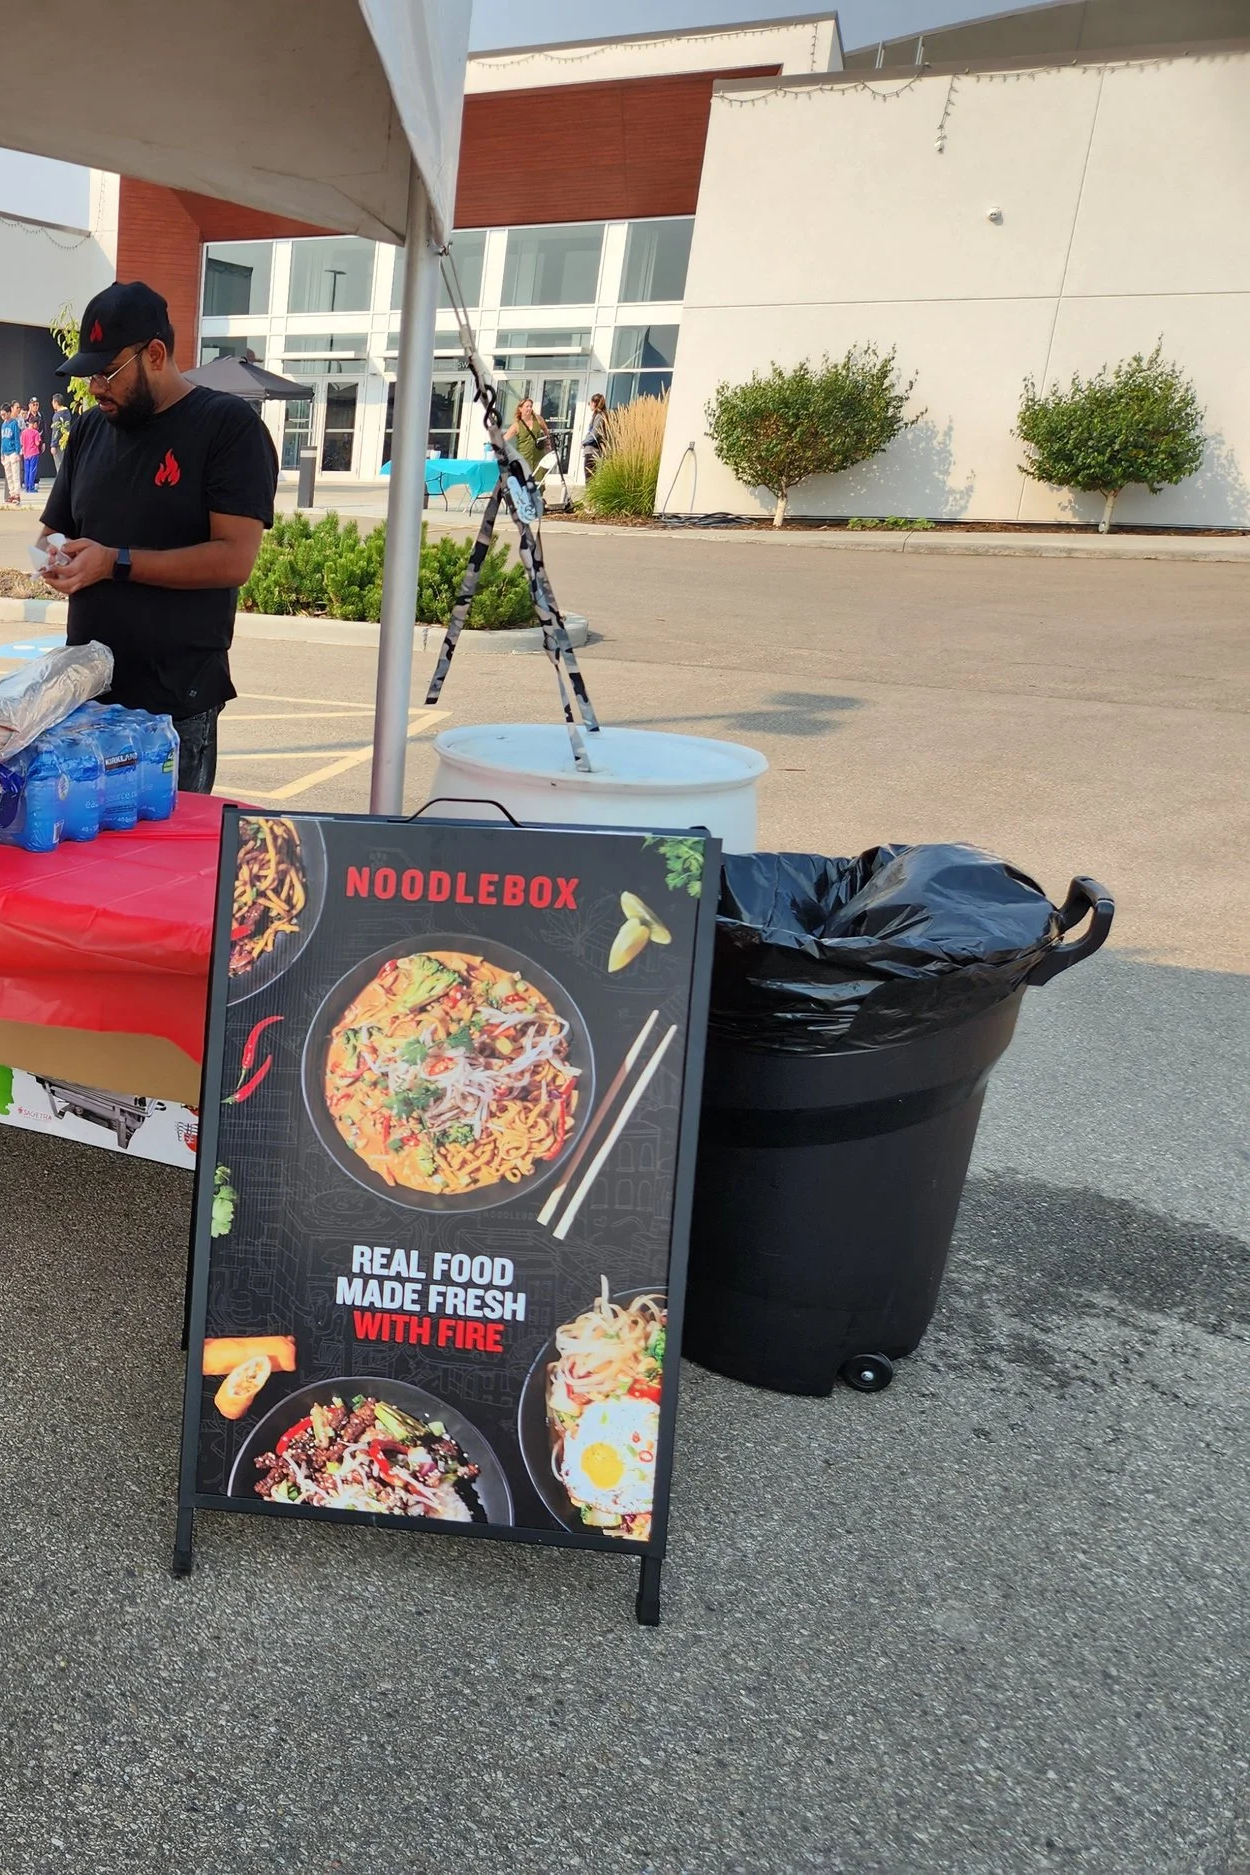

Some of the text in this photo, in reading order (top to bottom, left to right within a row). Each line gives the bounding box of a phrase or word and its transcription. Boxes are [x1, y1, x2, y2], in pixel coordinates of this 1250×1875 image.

[346, 866, 579, 910] NOODLEBOX
[351, 1245, 514, 1287] REAL FOOD
[335, 1276, 526, 1322] MADE FRESH
[353, 1310, 505, 1353] WITH FIRE
